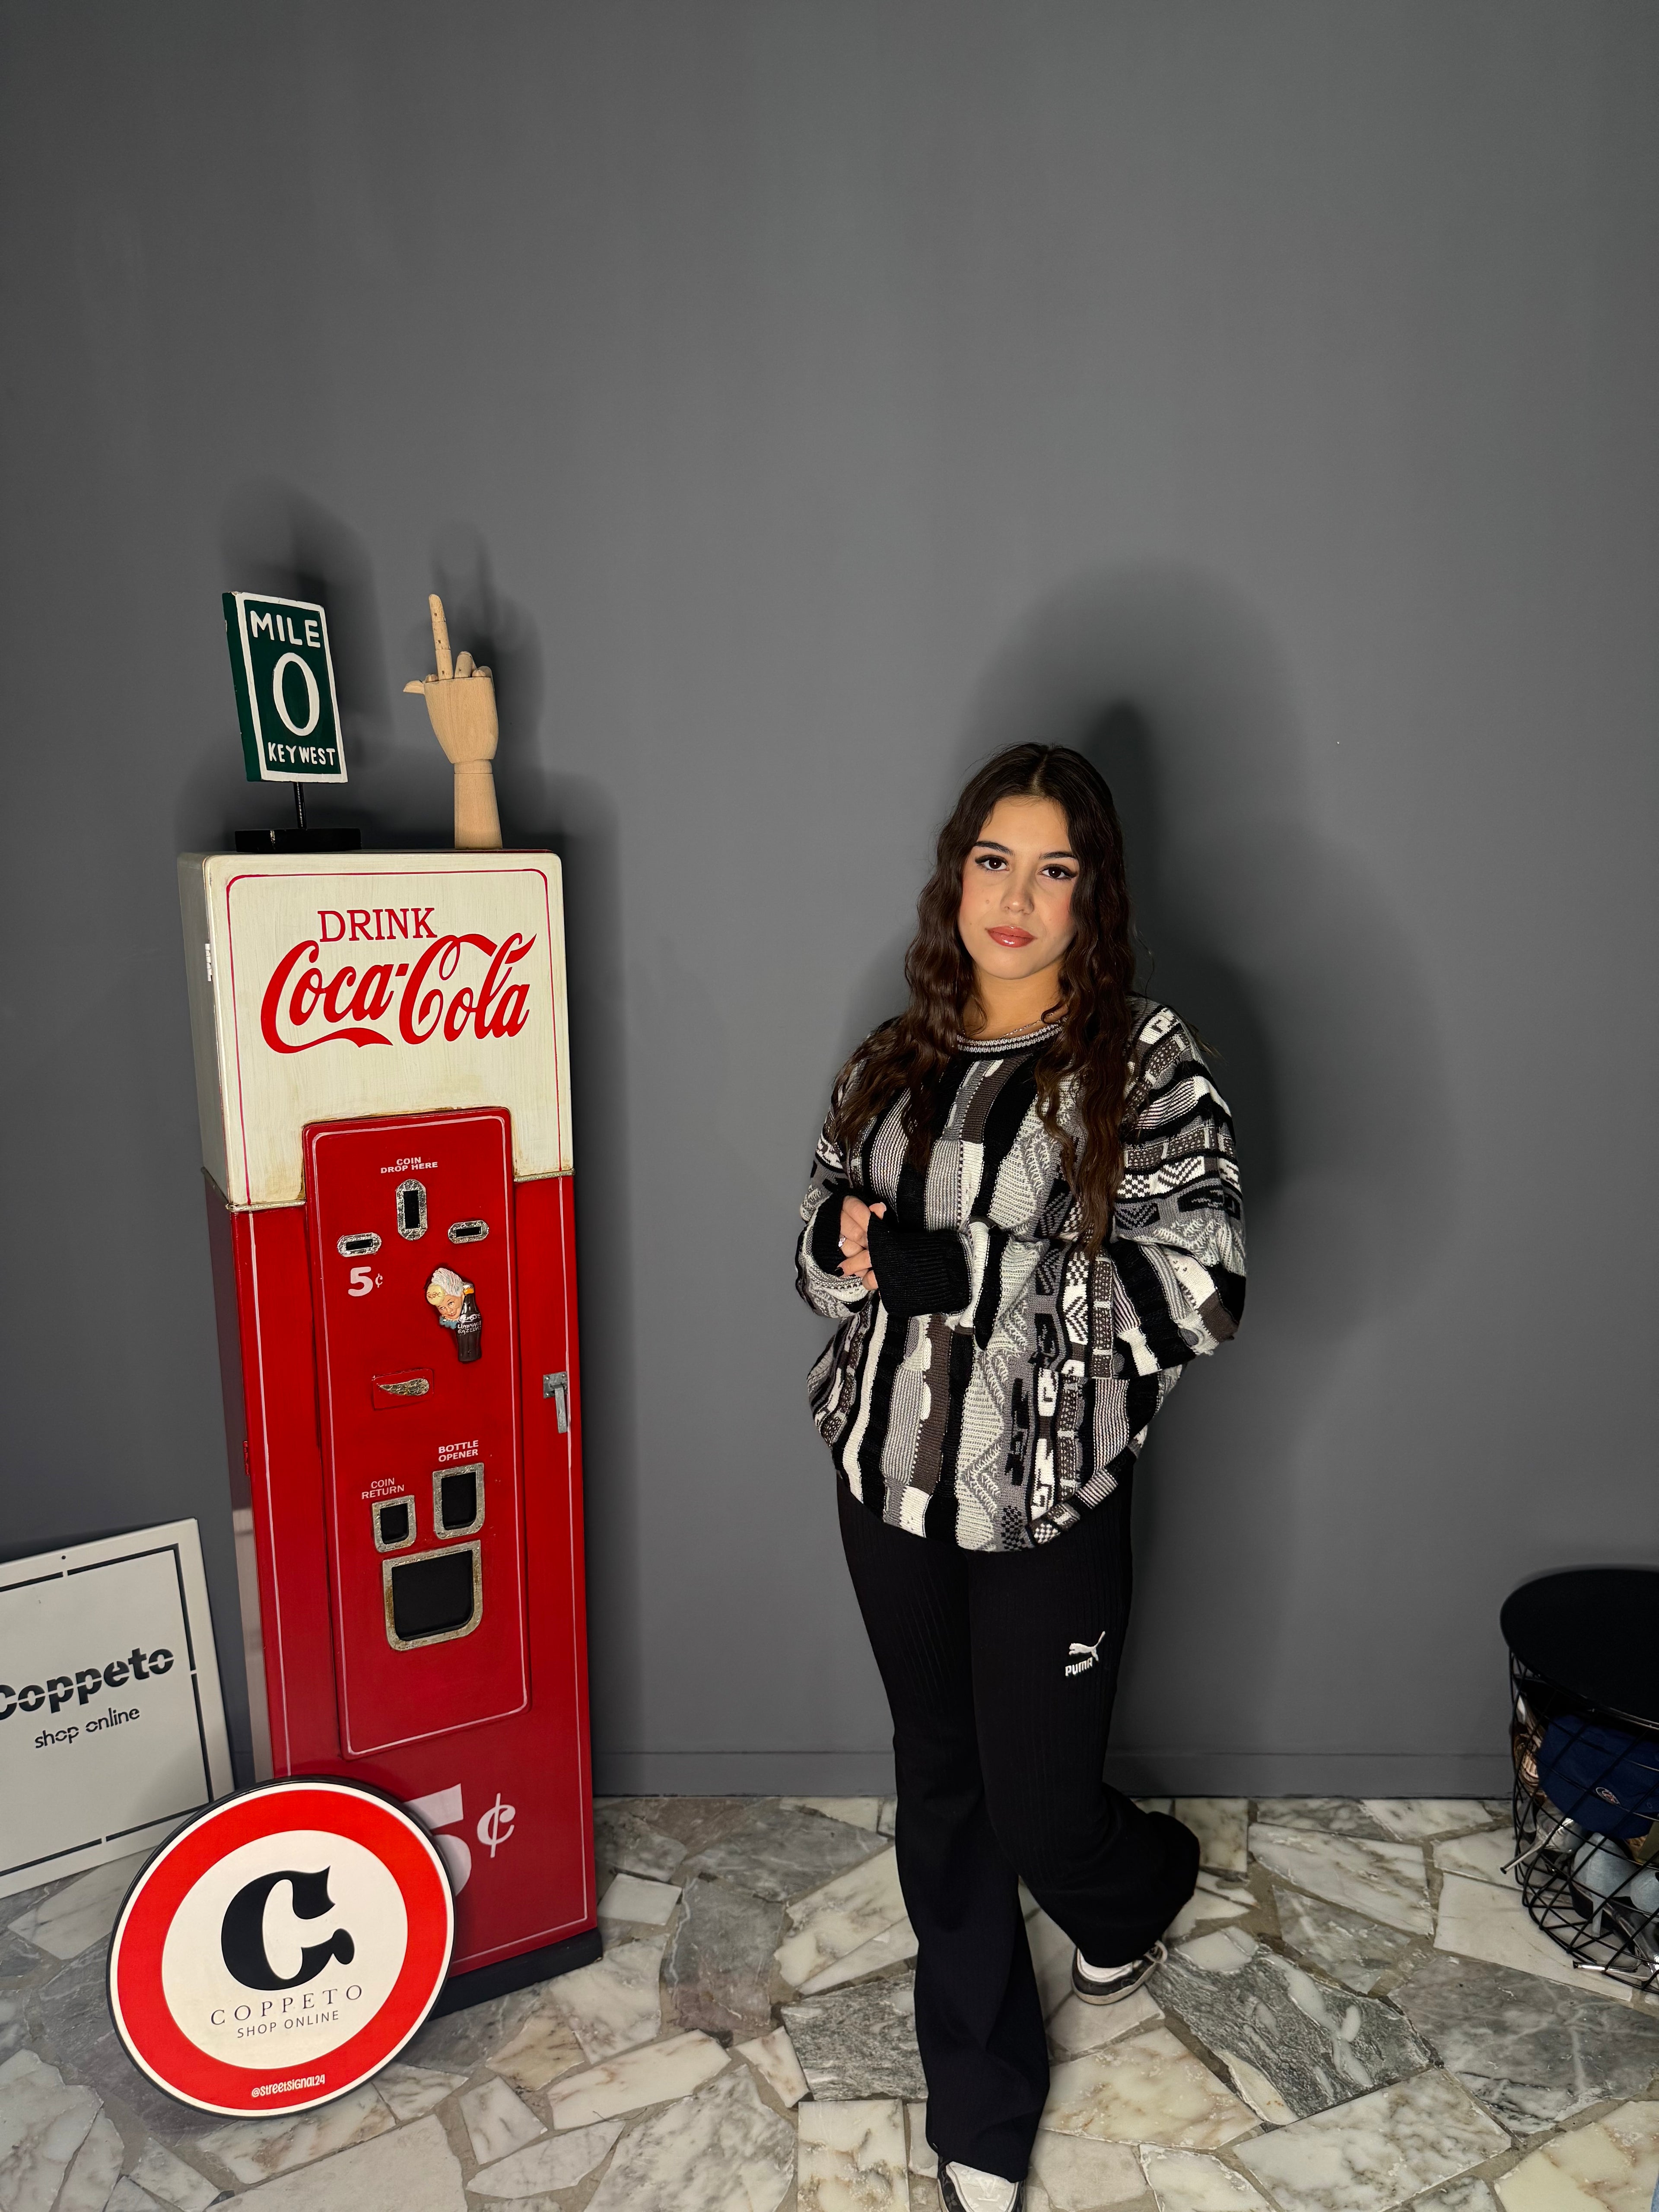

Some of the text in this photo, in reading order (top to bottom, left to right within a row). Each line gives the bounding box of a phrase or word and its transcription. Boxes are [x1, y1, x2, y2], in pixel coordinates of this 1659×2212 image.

[251, 610, 321, 648] MILE
[268, 742, 336, 766] KEY WEST
[318, 908, 437, 942] DRINK
[261, 932, 537, 1053] Coca-Cola
[380, 1161, 438, 1174] DROP HERE
[396, 1157, 421, 1166] COIN
[438, 1440, 479, 1454] BOTTLE
[438, 1449, 478, 1462] OPENER
[362, 1484, 404, 1500] RETURN
[371, 1478, 395, 1489] COIN
[1065, 1657, 1093, 1676] PUMA
[35, 1707, 140, 1749] shop online
[221, 1865, 355, 1991] C
[210, 1984, 362, 2026] COPPETO
[237, 2010, 340, 2038] SHOP ONLINE
